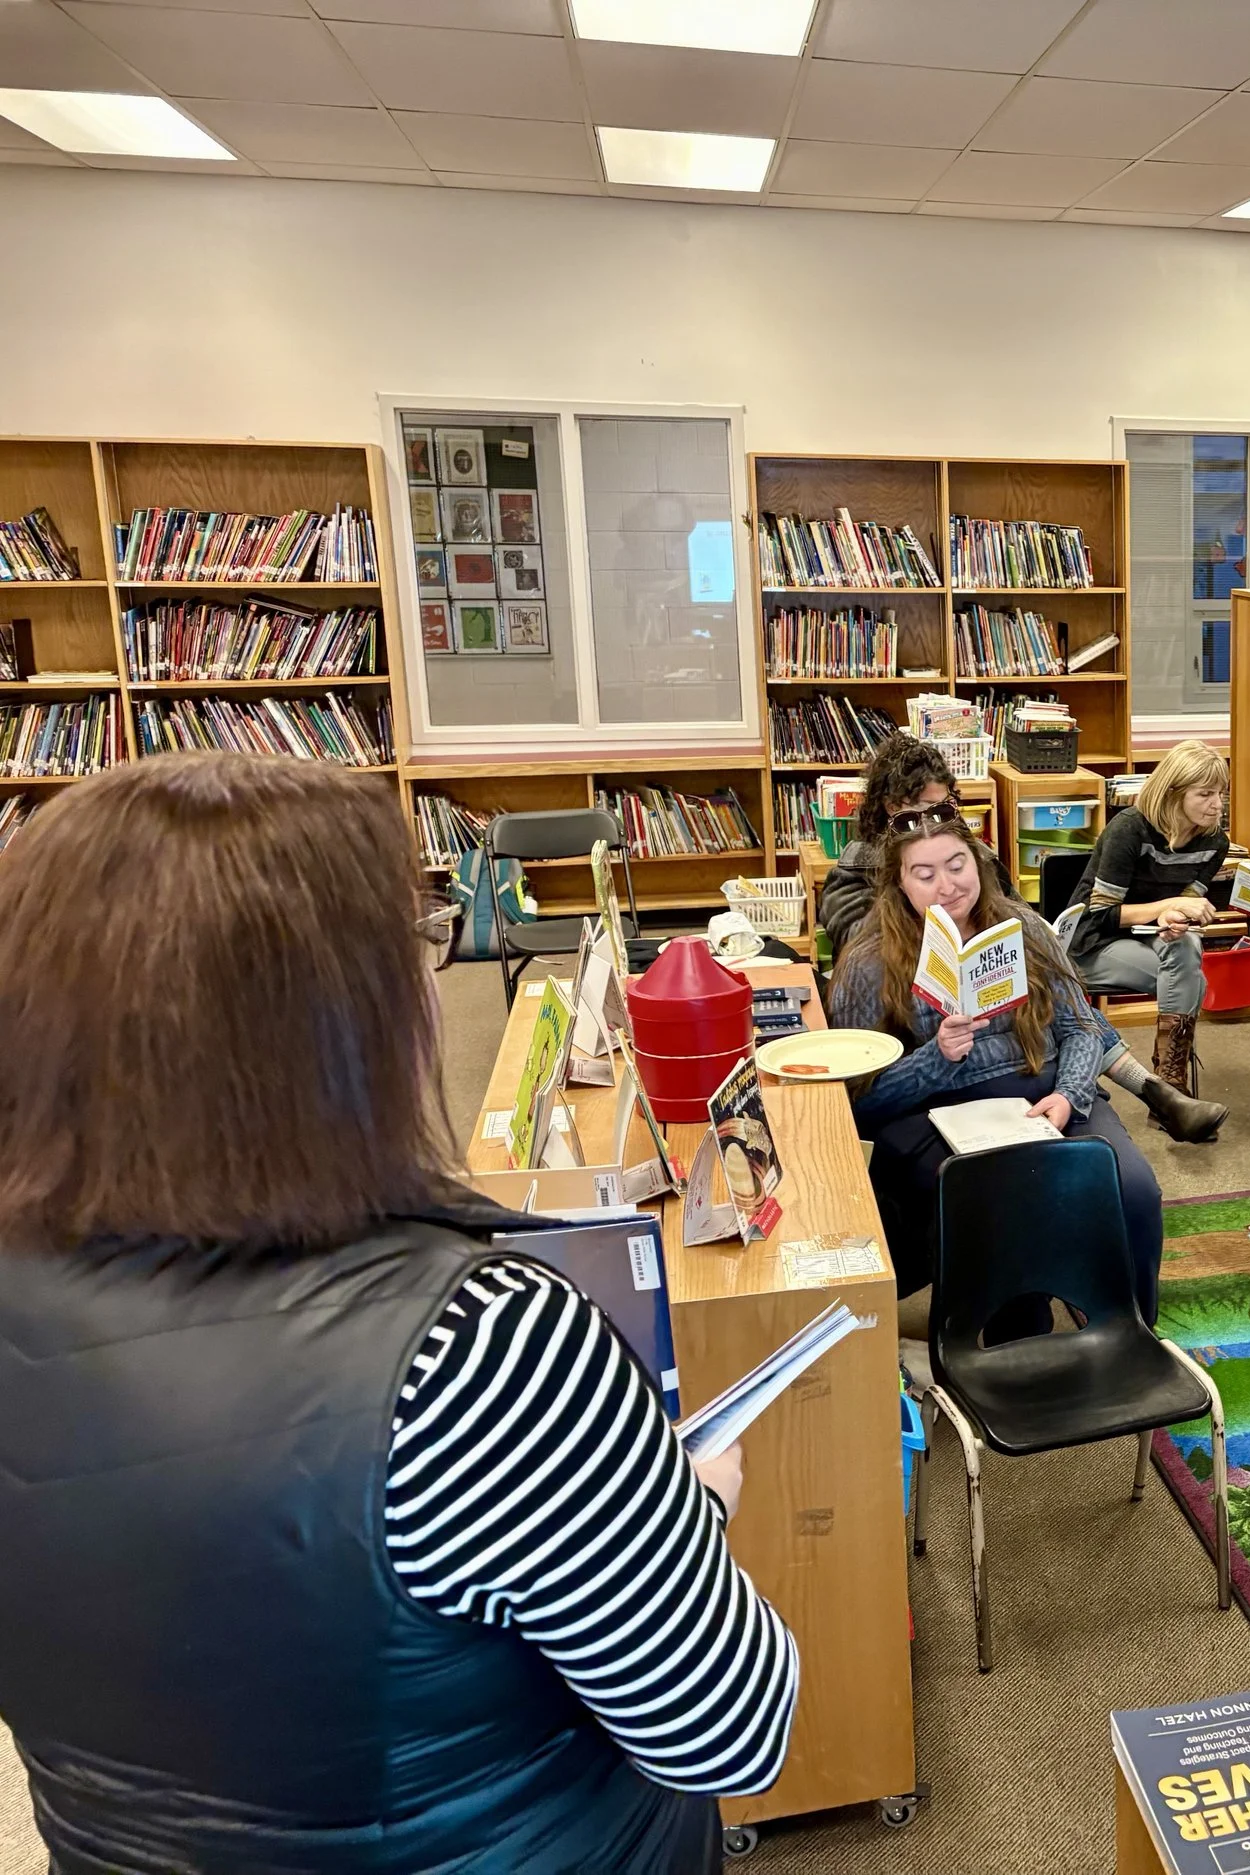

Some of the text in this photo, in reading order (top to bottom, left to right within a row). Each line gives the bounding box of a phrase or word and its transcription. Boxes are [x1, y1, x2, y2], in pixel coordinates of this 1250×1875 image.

[980, 942, 1004, 963] NEW
[969, 949, 1018, 981] TEACHER
[973, 966, 1014, 989] CONFIDENTIAL
[1155, 1709, 1208, 1727] HAZEL
[1186, 1730, 1237, 1744] Outcomes
[1204, 1736, 1250, 1751] Teaching
[1179, 1749, 1231, 1766] Strategies
[1182, 1747, 1203, 1757] and
